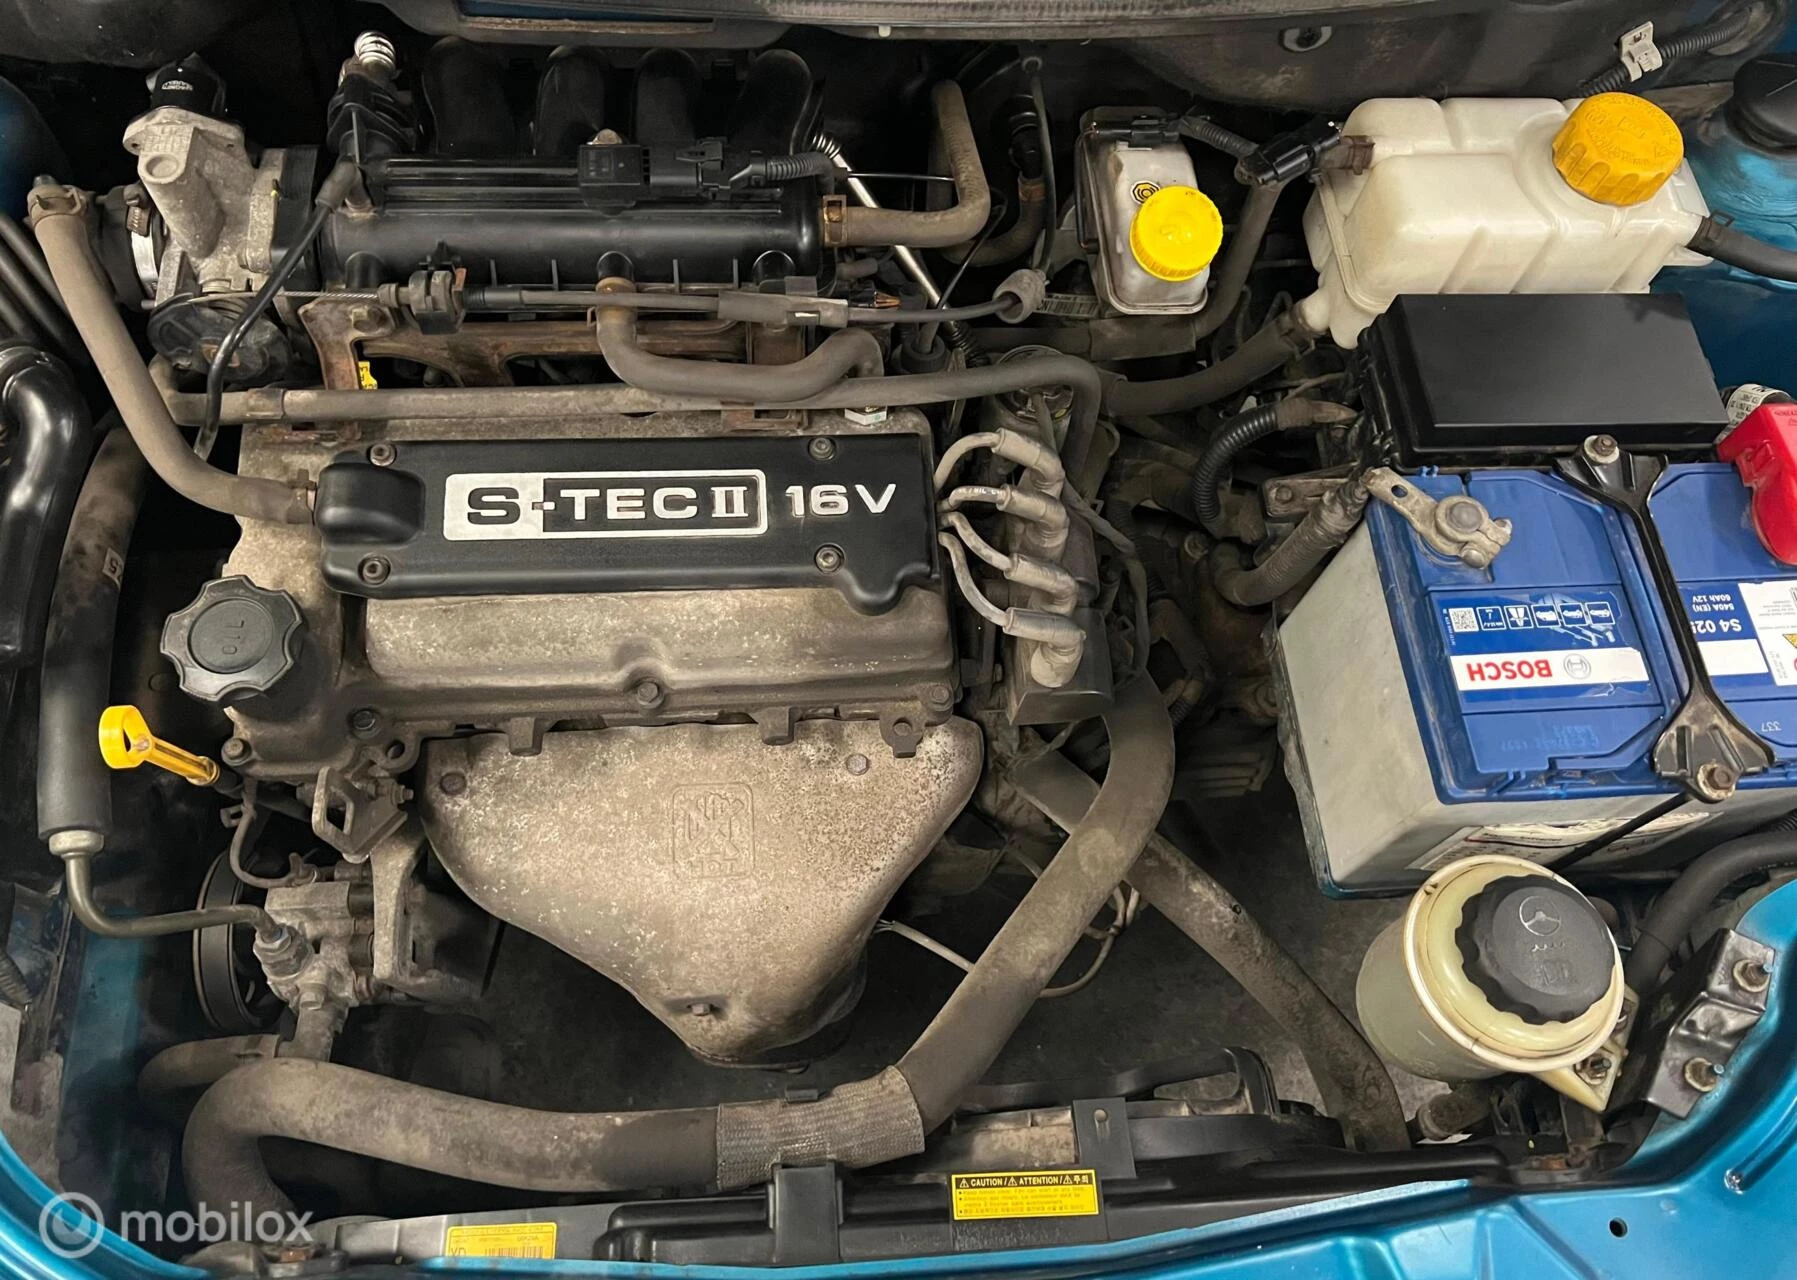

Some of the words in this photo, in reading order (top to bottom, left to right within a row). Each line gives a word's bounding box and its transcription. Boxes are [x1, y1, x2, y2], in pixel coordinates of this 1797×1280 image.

[1692, 595, 1708, 603] 12V
[1719, 618, 1742, 632] S4
[1466, 659, 1553, 682] BOSCH
[1019, 1176, 1057, 1185] ATTENTION
